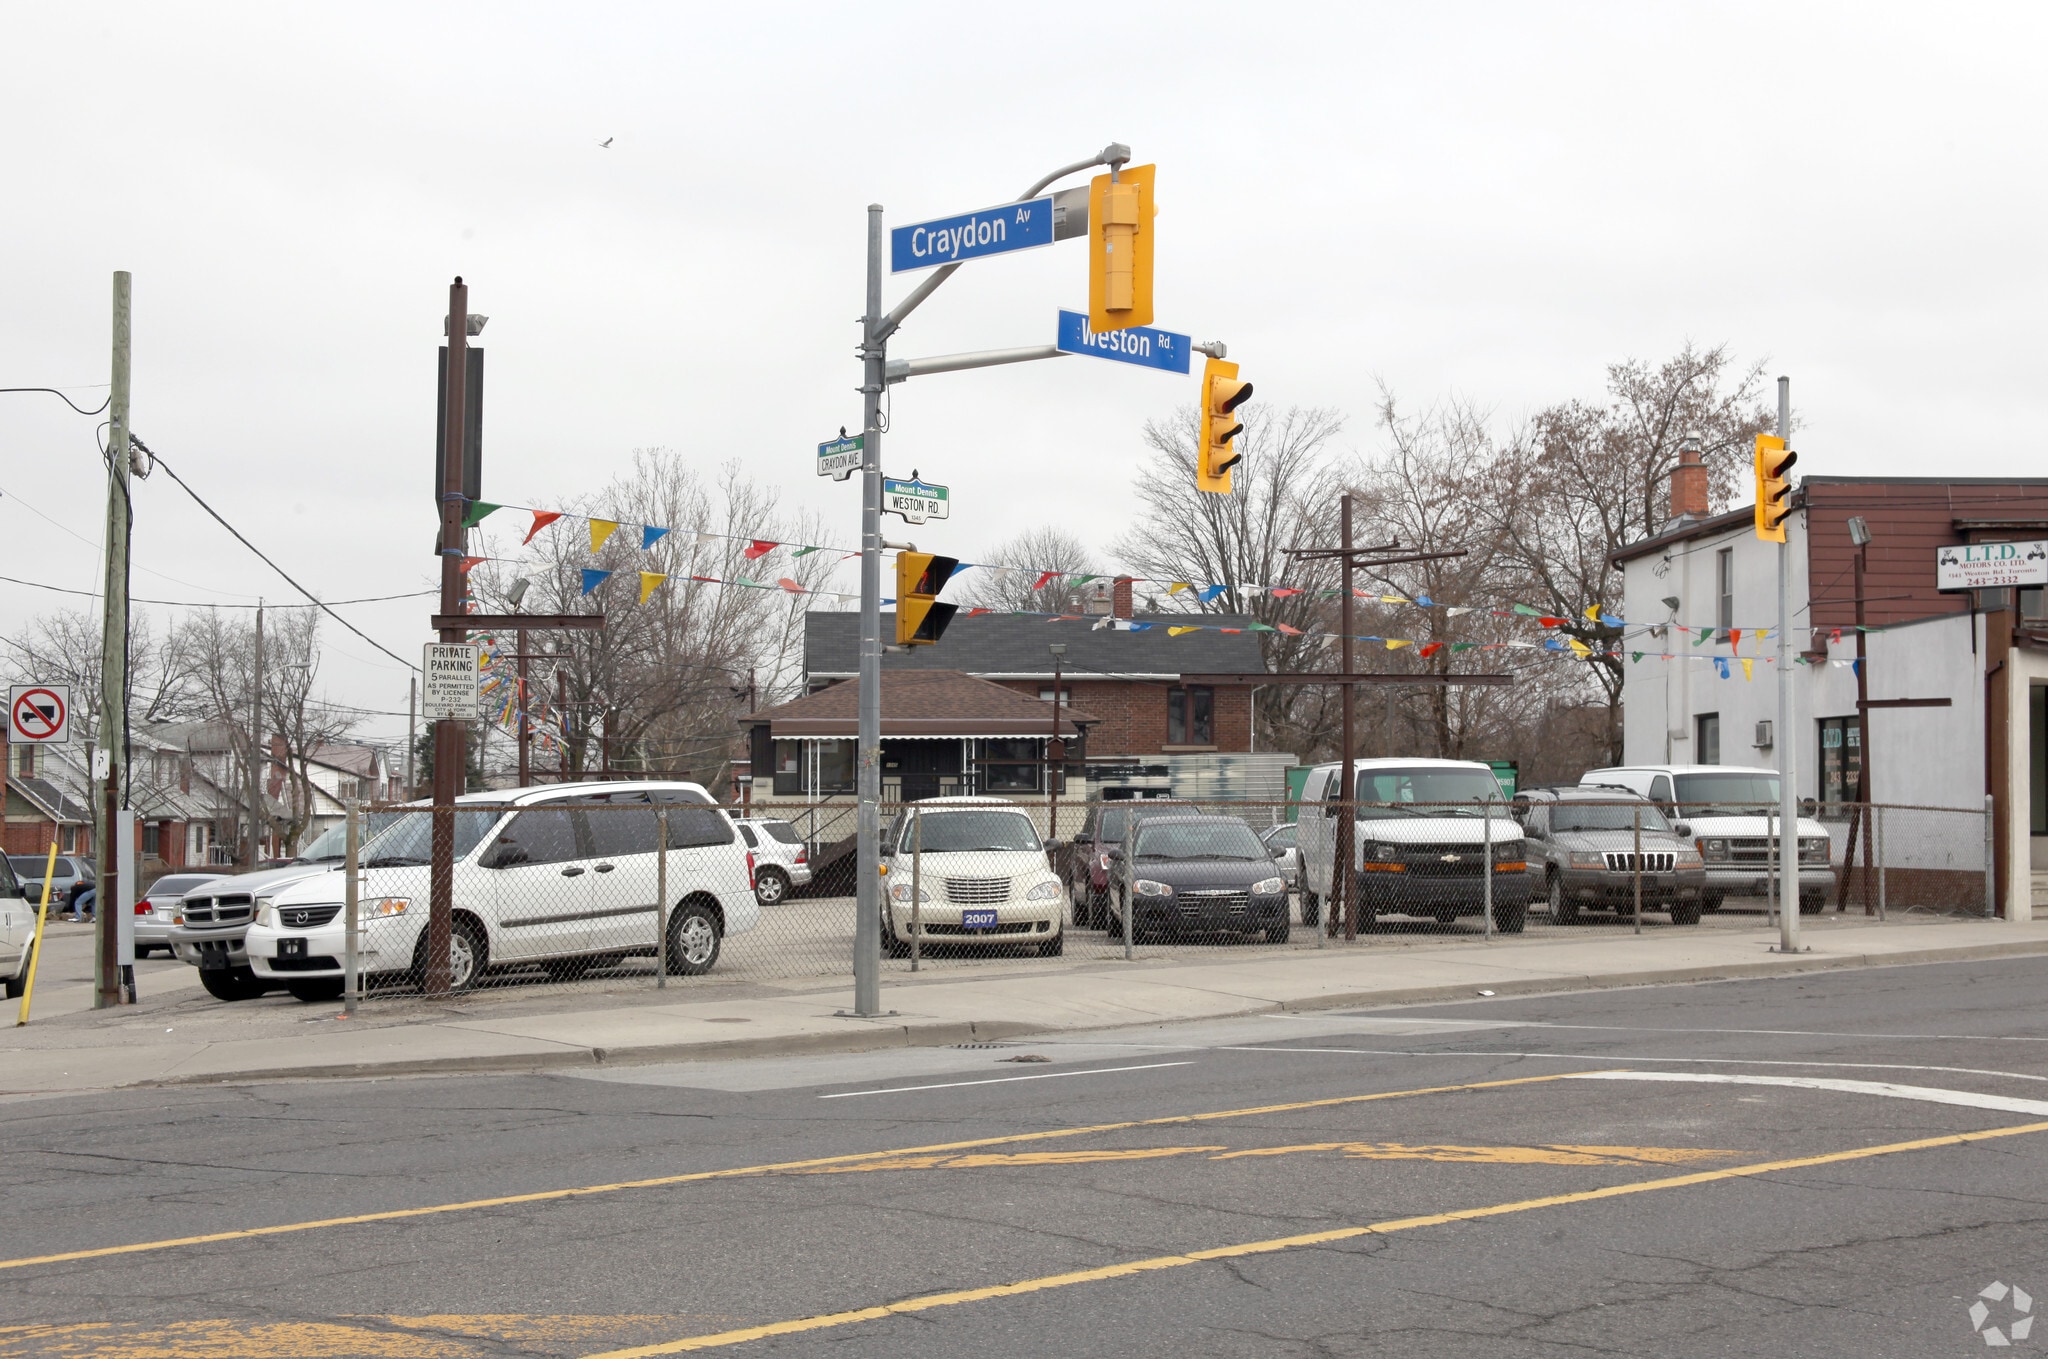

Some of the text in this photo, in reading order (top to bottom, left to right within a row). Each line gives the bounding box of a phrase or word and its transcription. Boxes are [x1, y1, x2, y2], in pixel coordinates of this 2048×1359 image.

[912, 208, 1031, 259] Craydon Av
[1081, 318, 1150, 358] Weston
[825, 441, 857, 454] Mount Dennis
[821, 454, 847, 471] CRAYDON
[895, 484, 938, 498] Mount Dennis
[892, 496, 924, 512] WESTON
[1965, 544, 2021, 562] L.T.D.
[1967, 575, 2019, 586] 243-2332
[432, 647, 471, 658] PRIVATE
[431, 660, 472, 672] PARKING
[431, 673, 438, 681] 5
[965, 914, 995, 924] 2007
